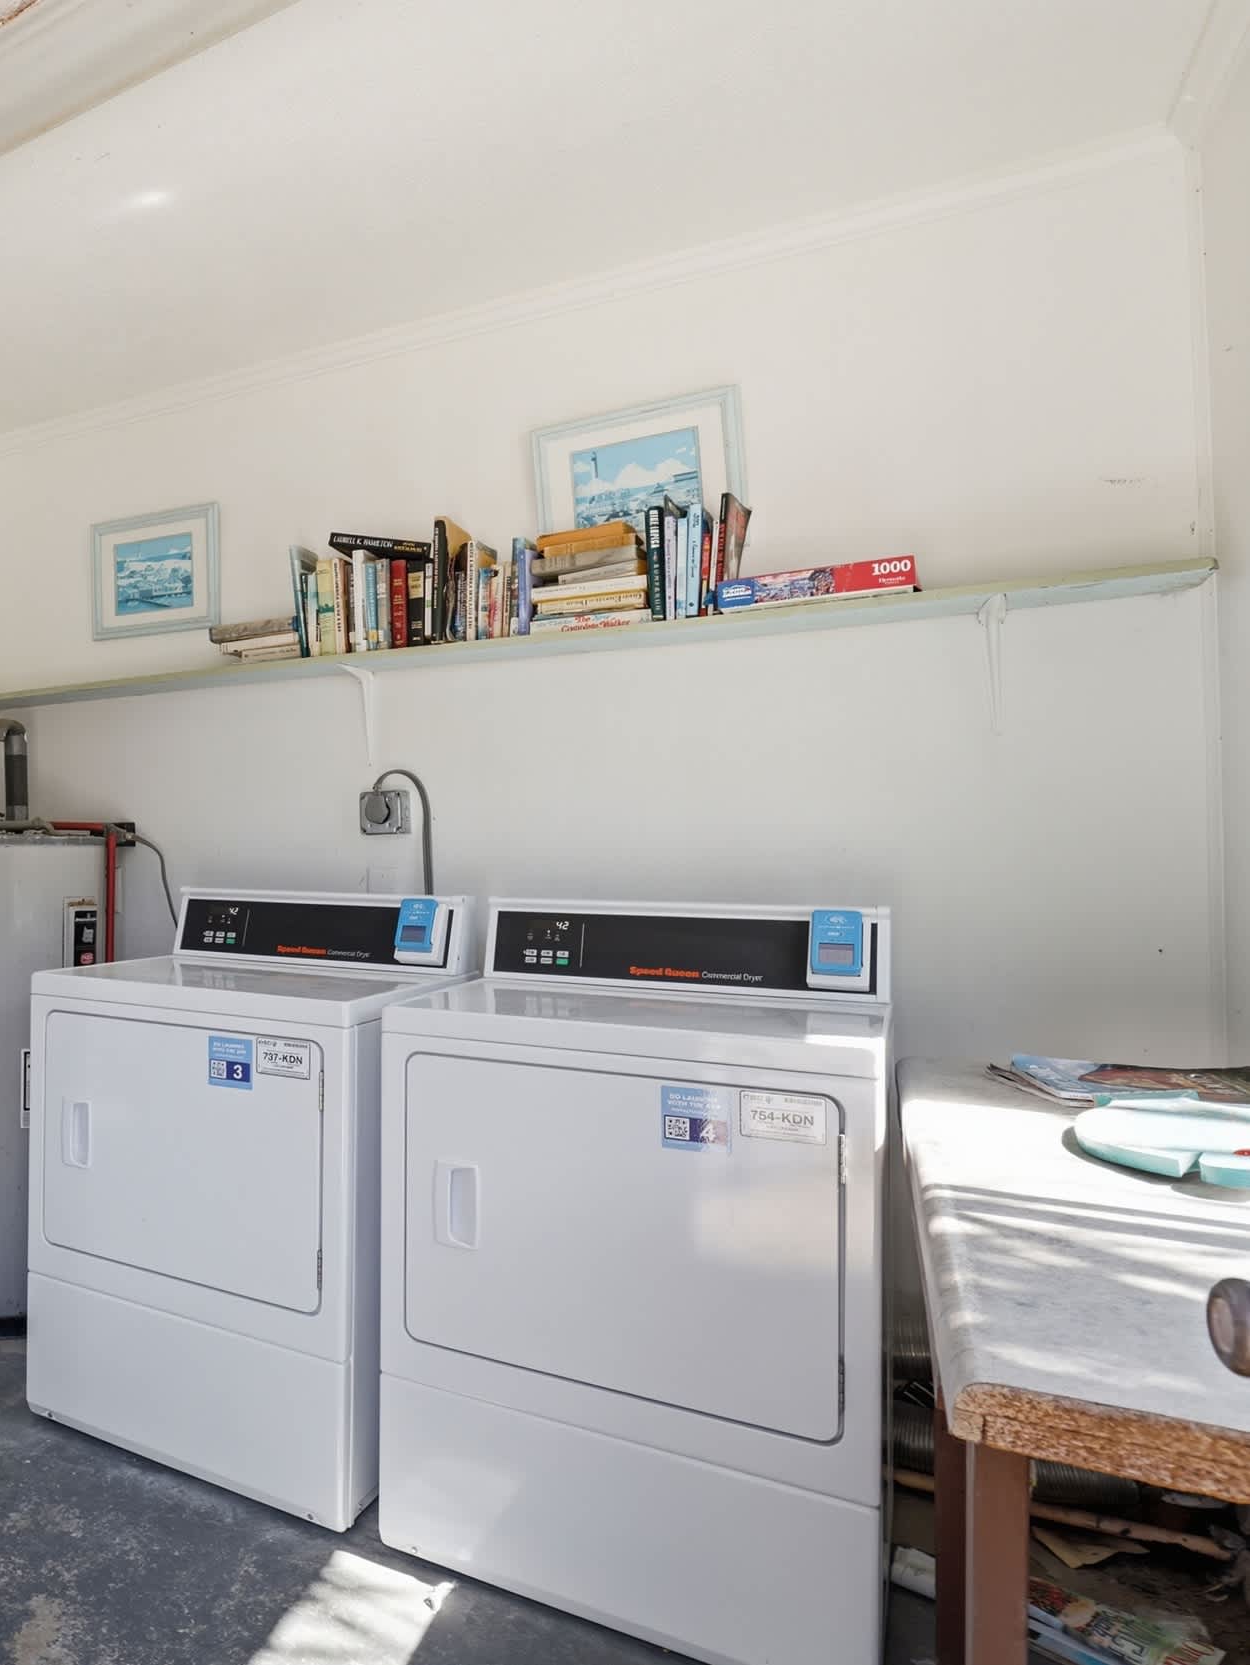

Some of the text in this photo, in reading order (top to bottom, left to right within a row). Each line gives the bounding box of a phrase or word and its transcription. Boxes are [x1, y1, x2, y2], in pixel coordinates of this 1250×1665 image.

[871, 559, 912, 576] 1000
[556, 920, 570, 931] 42
[630, 965, 764, 984] Speed Queen Commercial Dryer
[262, 1051, 303, 1065] 737-KDN
[233, 1064, 243, 1079] 3
[750, 1109, 814, 1127] 754-KDN
[700, 1123, 715, 1141] 4
